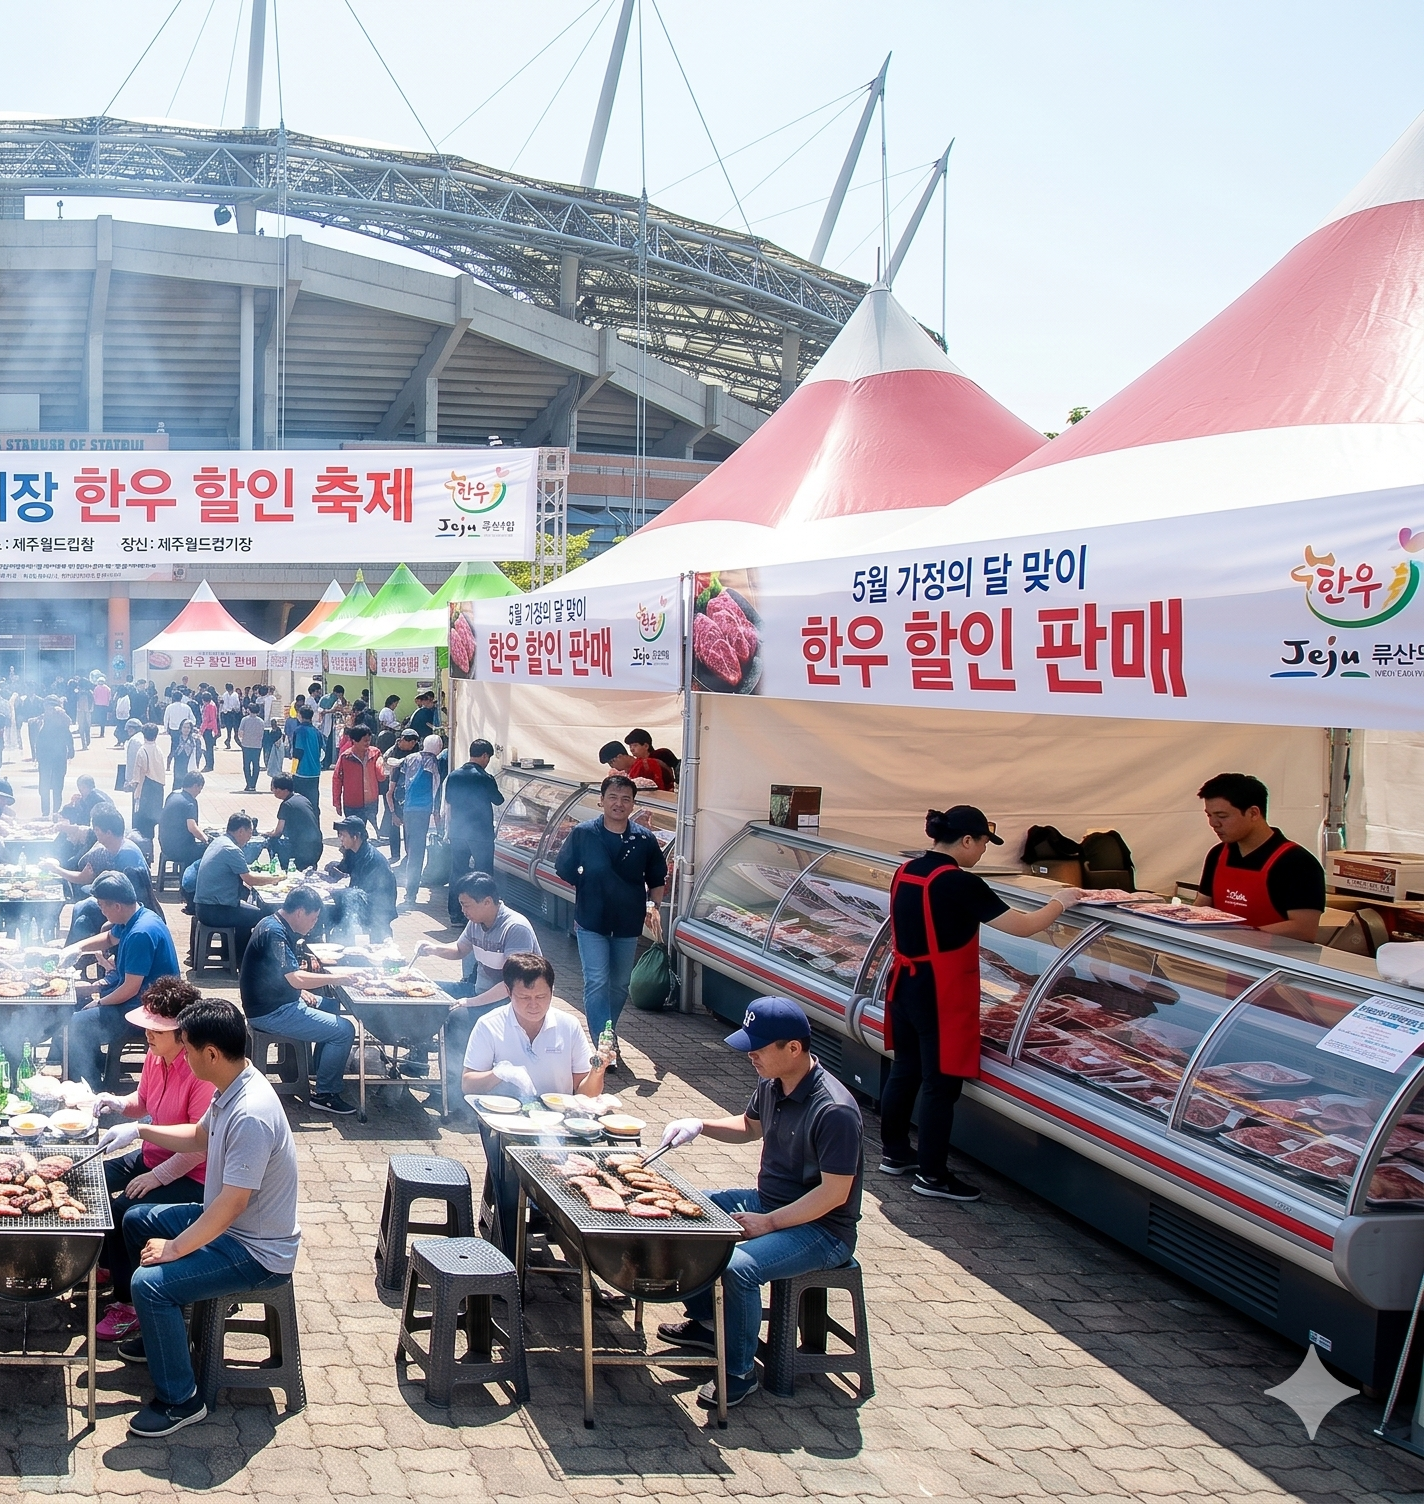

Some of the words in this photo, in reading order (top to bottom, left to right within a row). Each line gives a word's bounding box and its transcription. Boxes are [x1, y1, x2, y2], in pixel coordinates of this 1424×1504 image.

[74, 467, 177, 523] 한우
[193, 466, 295, 524] 할인
[311, 466, 414, 524] 축제
[852, 565, 888, 604] 5월
[896, 556, 973, 602] 가정의
[983, 552, 1013, 596] 달
[1022, 544, 1087, 594] 맞이
[1313, 559, 1381, 608] 한우
[489, 632, 521, 674] 한우
[525, 631, 563, 676] 할인
[568, 628, 612, 677] 판매
[801, 615, 889, 688] 한우
[904, 607, 1017, 692] 할인
[1035, 597, 1187, 698] 판매
[1281, 635, 1360, 678] Jeju
